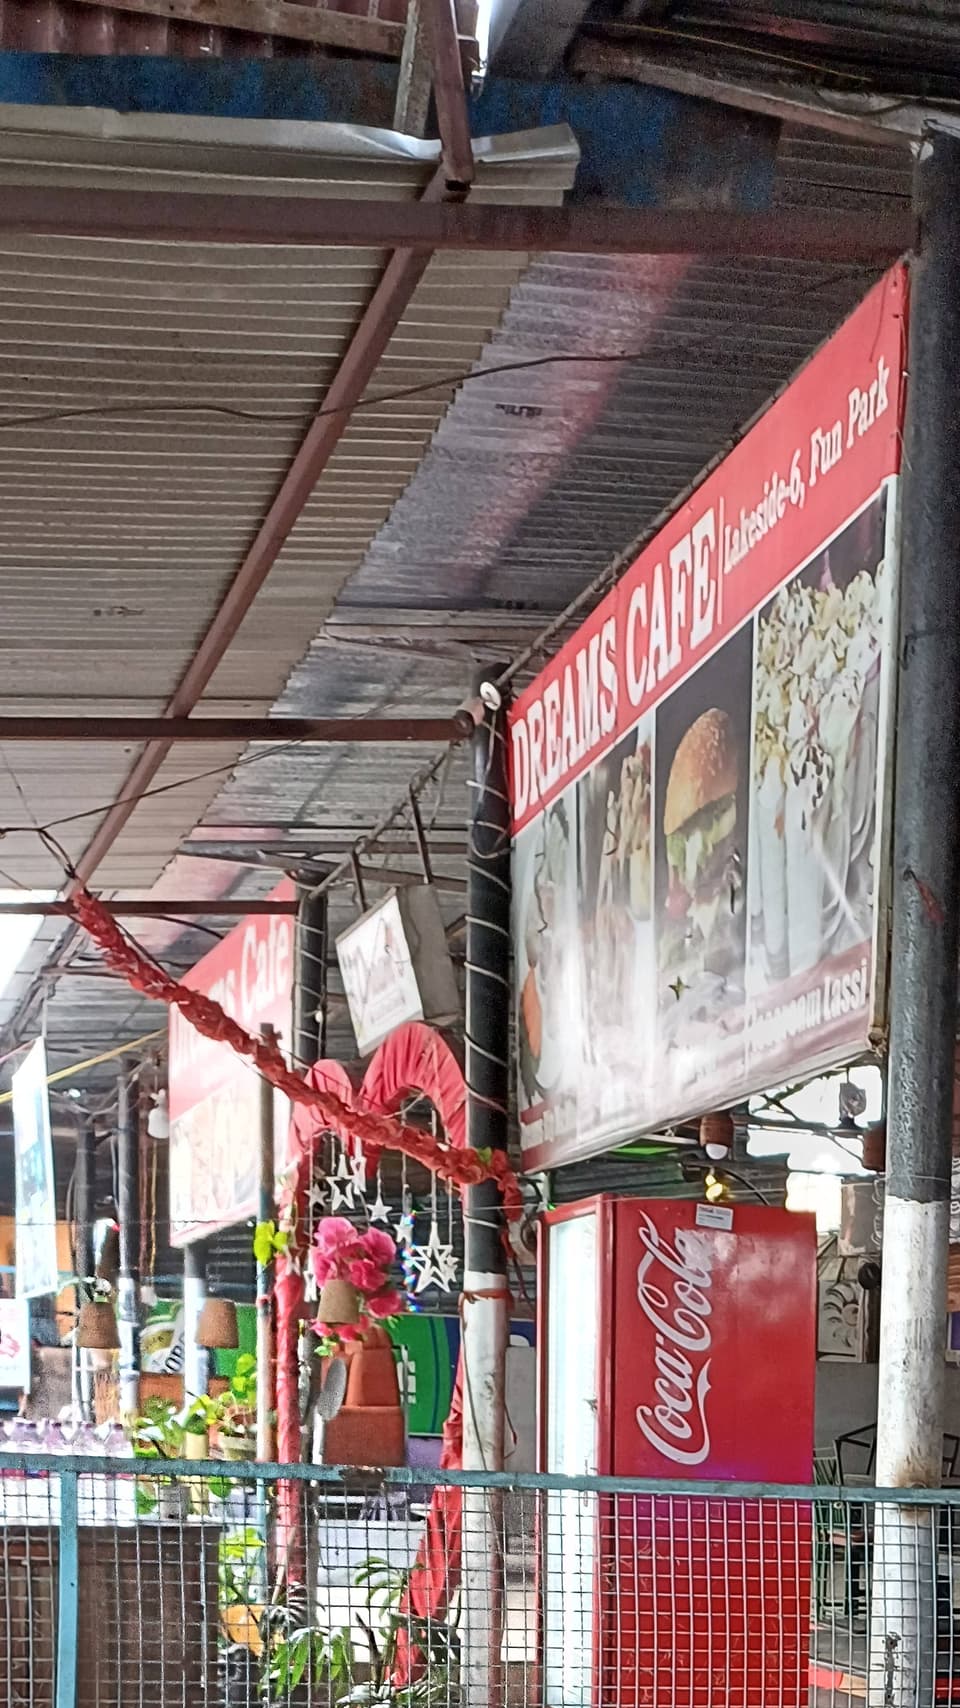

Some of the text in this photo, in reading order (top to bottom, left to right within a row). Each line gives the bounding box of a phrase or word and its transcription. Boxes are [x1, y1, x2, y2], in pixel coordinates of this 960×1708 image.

[511, 355, 890, 821] DREAMS CAFE Lakeside-6, Fun Park
[823, 957, 868, 1022] Lassi
